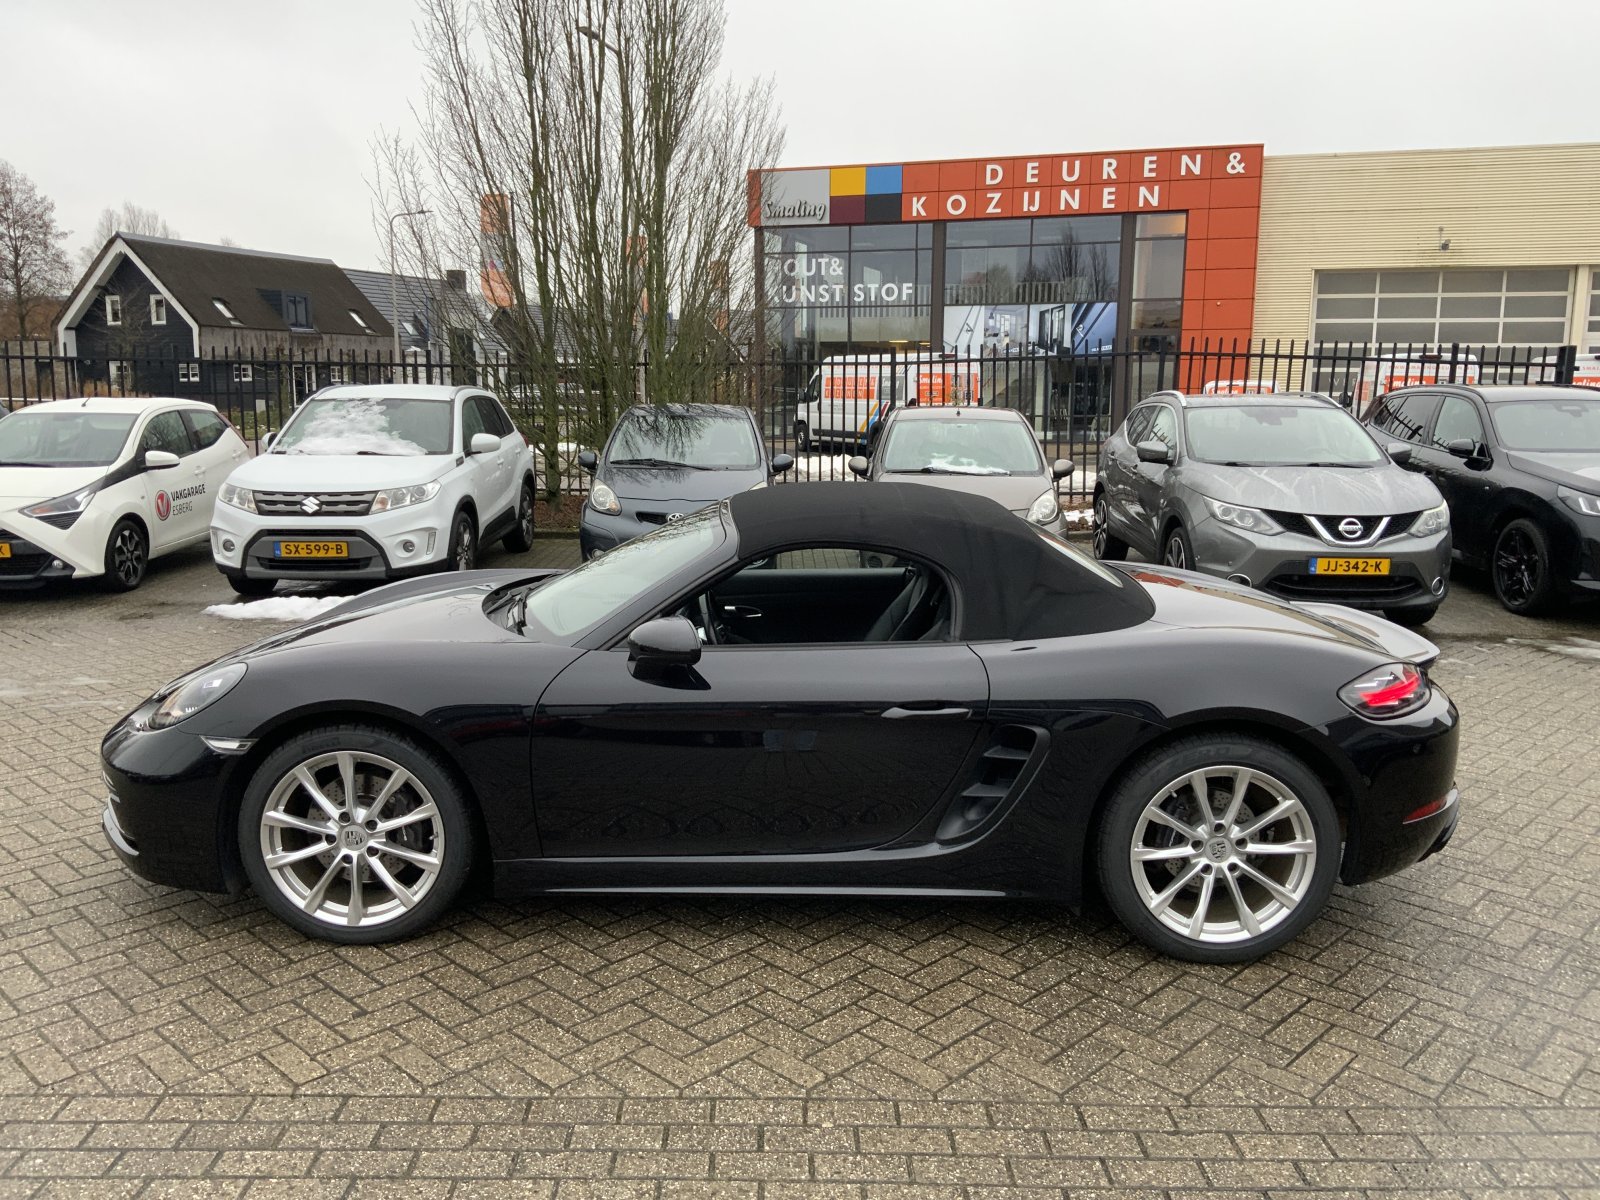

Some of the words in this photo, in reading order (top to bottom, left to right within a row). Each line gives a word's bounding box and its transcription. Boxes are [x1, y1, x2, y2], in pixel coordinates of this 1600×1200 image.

[985, 154, 1202, 186] DEUREN
[1226, 151, 1246, 175] &
[764, 200, 827, 221] Smaling
[911, 185, 1160, 217] KOZIJNEN
[765, 257, 844, 277] OUT&
[766, 284, 844, 303] UNST
[852, 282, 914, 302] STOF
[171, 484, 206, 501] VAKGARAGE
[172, 501, 193, 516] ESBERG
[284, 543, 344, 555] SX-599-B
[1323, 560, 1382, 573] JJ-342-K
